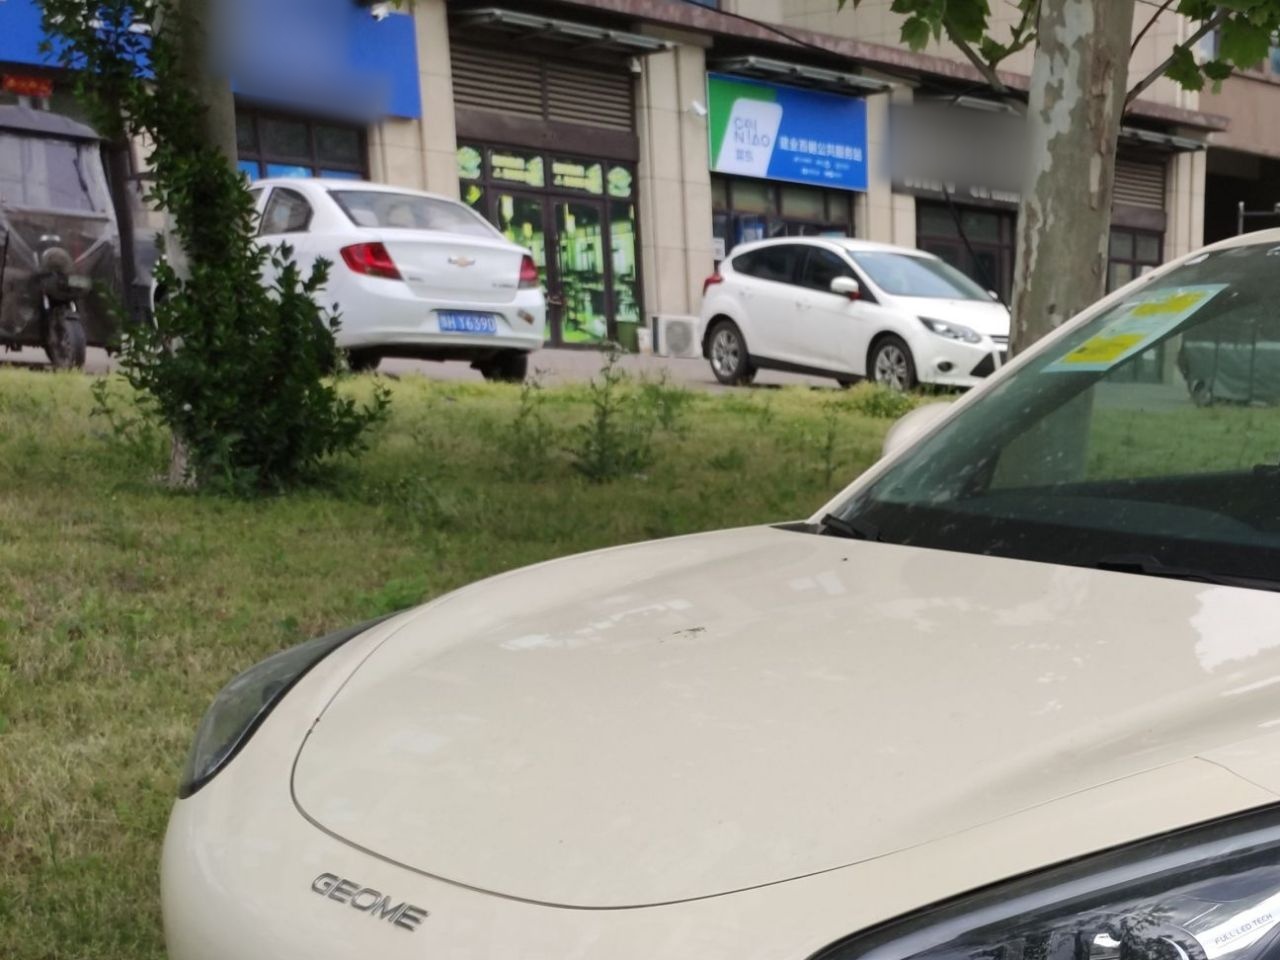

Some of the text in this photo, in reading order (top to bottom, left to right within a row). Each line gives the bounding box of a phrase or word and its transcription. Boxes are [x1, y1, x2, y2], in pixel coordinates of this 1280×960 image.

[311, 872, 430, 932] GEOME
[1214, 913, 1273, 944] FULL LED TECH
